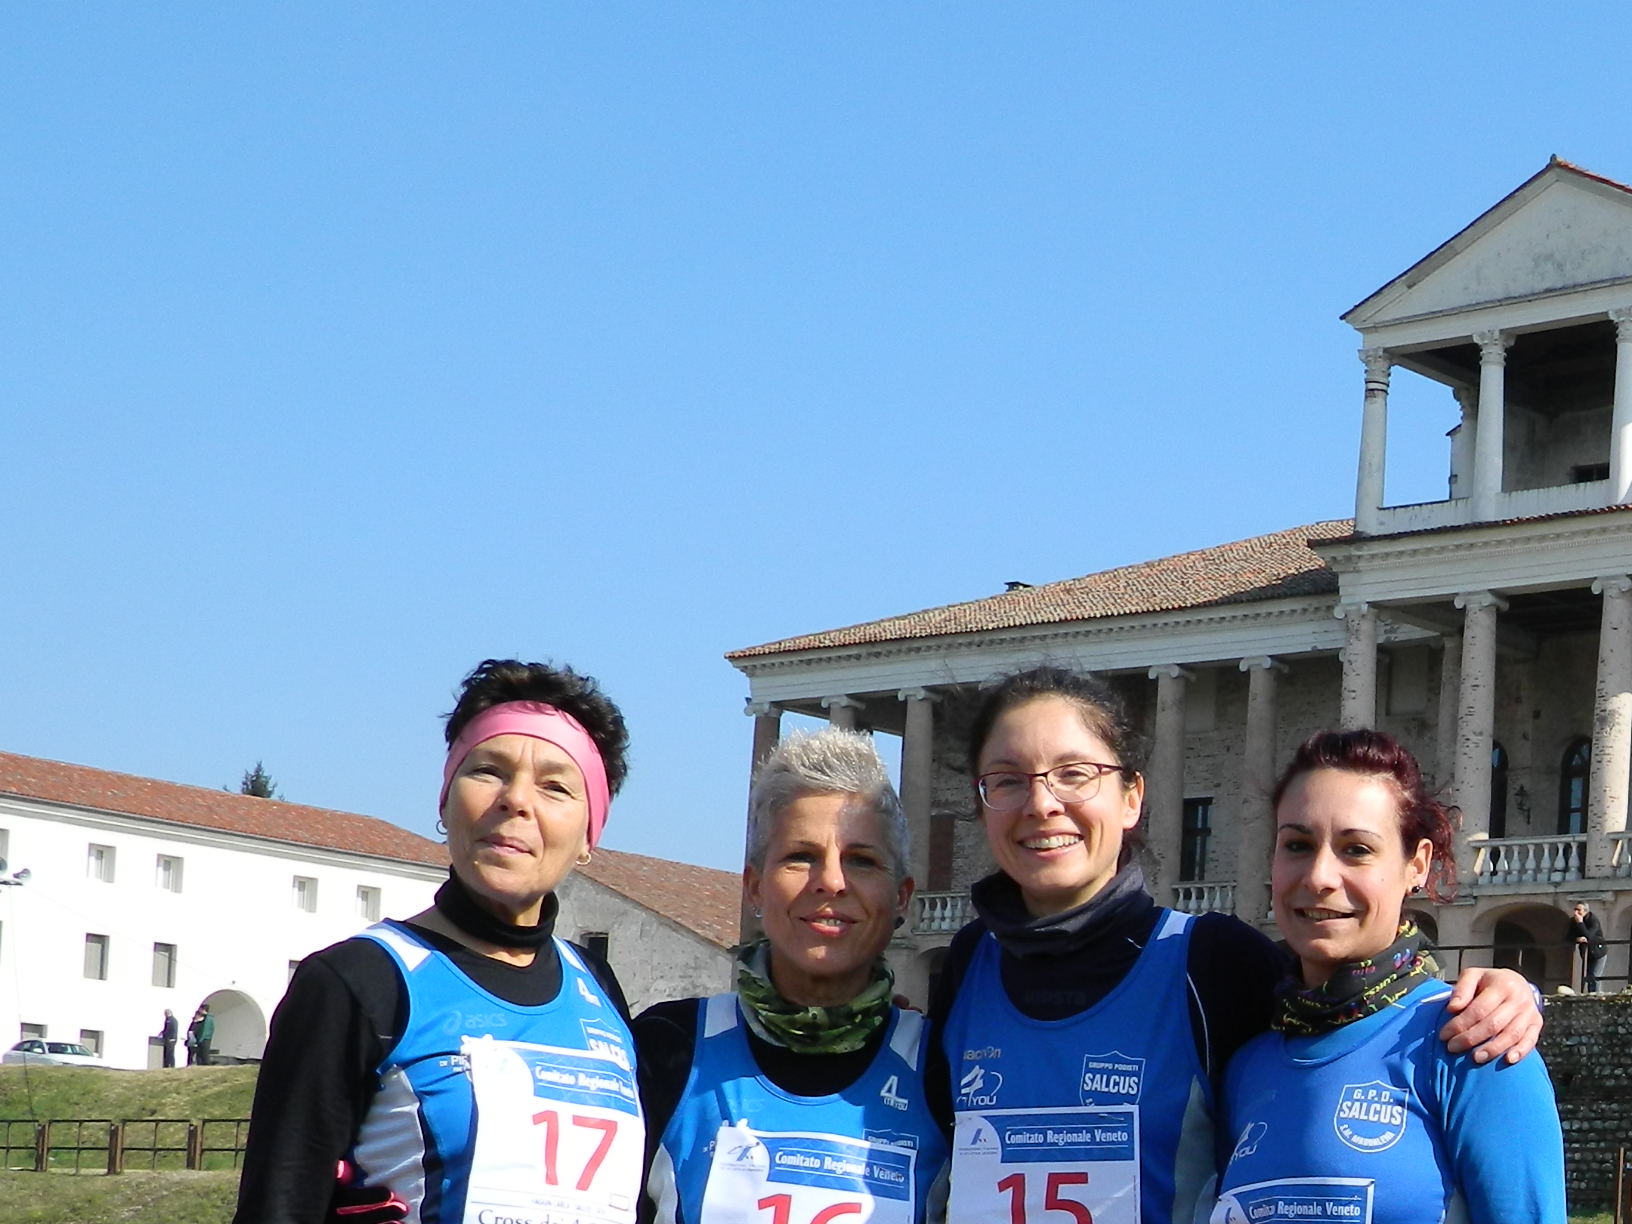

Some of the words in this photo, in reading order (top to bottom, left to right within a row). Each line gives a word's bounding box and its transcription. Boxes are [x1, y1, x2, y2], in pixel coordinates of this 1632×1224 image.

[535, 1066, 576, 1086] Comitato
[1083, 1073, 1140, 1095] SALCUS
[1340, 1101, 1402, 1126] SALCUS
[1005, 1131, 1043, 1144] Comitato
[1047, 1130, 1091, 1145] Regionale
[1095, 1129, 1128, 1142] Veneto
[532, 1110, 618, 1191] 17
[775, 1152, 820, 1169] Comitato
[824, 1156, 871, 1176] Regionale
[873, 1164, 904, 1183] Veneto
[1277, 1201, 1322, 1218] Regionale
[1326, 1201, 1361, 1216] Veneto
